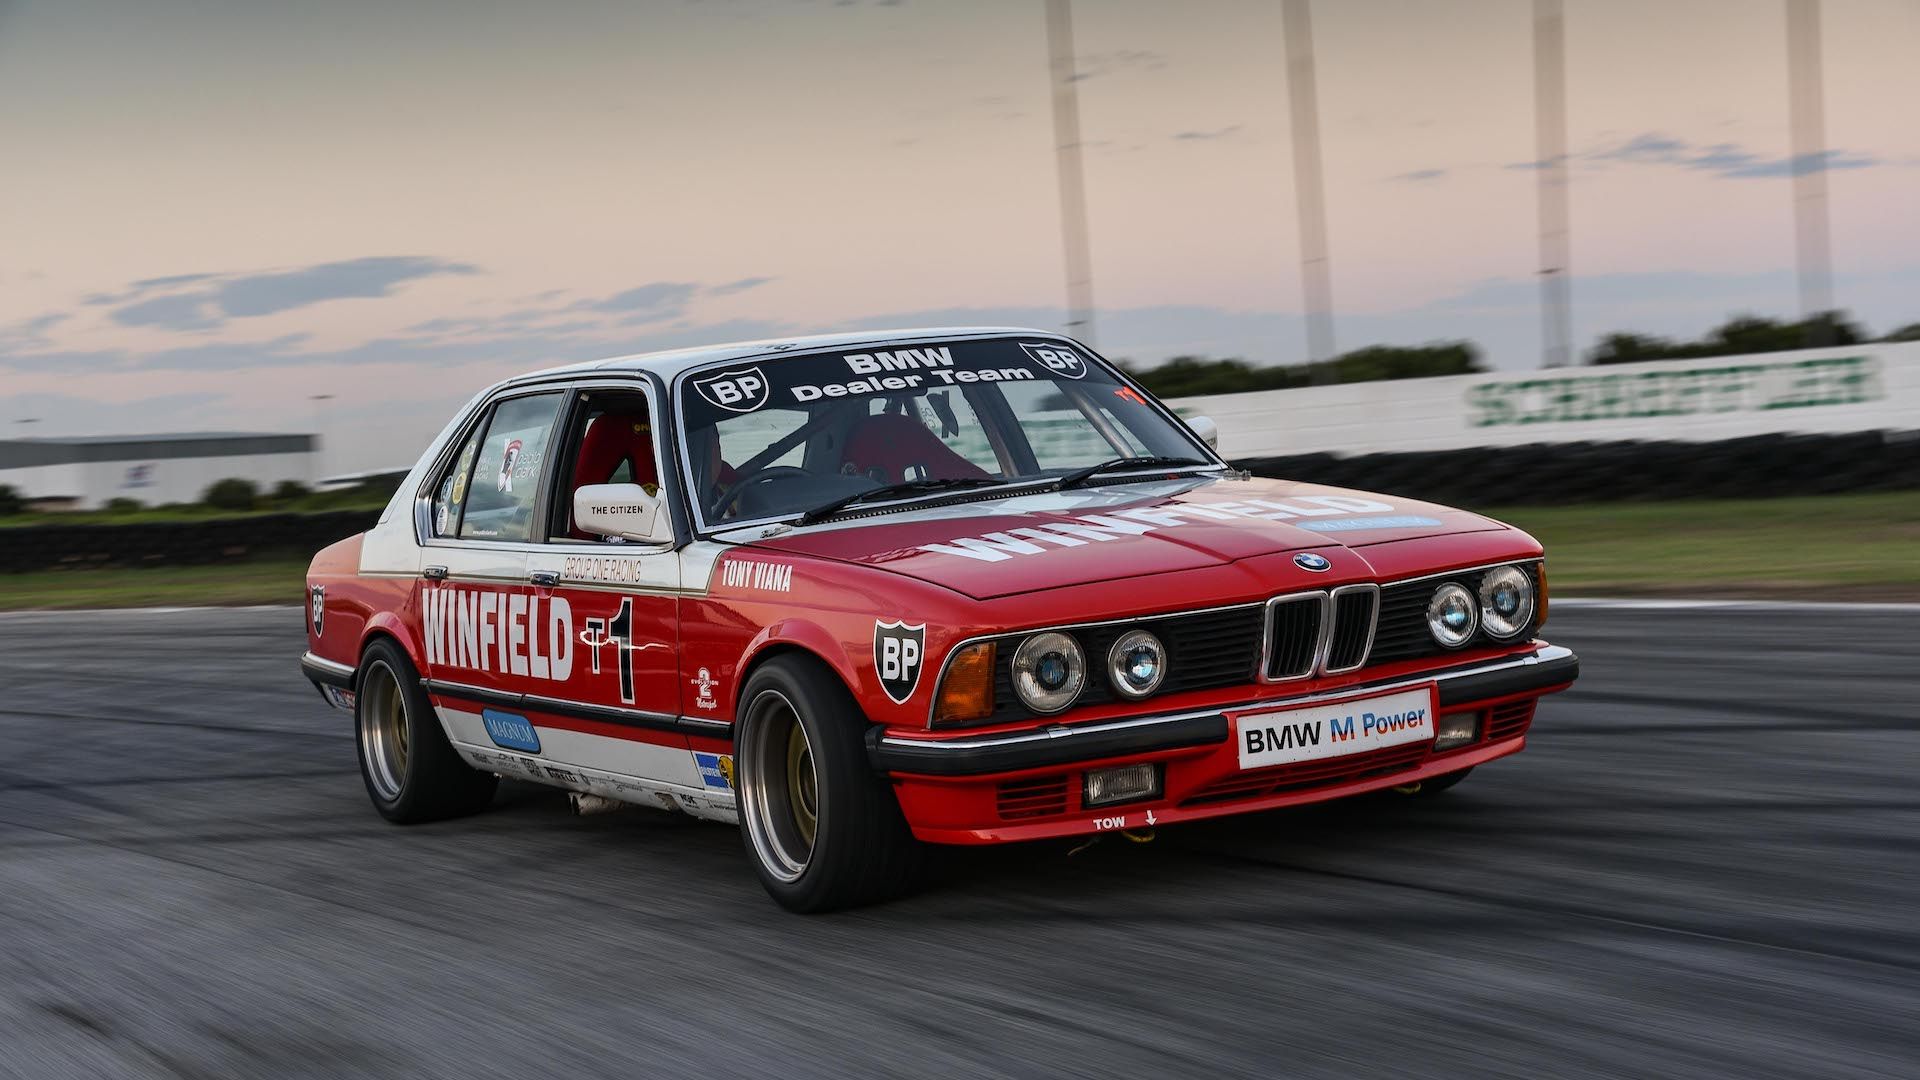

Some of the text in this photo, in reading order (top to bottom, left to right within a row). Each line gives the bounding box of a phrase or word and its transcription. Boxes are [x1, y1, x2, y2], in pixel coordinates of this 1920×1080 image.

[843, 347, 954, 375] BMW
[1035, 349, 1079, 370] BP
[709, 376, 762, 404] BP
[790, 364, 1035, 402] Dealer Team
[592, 505, 643, 515] THE CITIZEN
[915, 495, 1394, 562] WINFIELD
[565, 558, 641, 582] GROUP ONE RACING
[722, 560, 793, 592] TONY VIANA
[313, 594, 323, 622] BP
[422, 588, 573, 681] WINFIELD
[882, 637, 918, 681] BP
[698, 667, 712, 699] 2
[488, 718, 534, 743] MAGNUM
[1245, 707, 1426, 754] BMW M Power
[1093, 816, 1125, 830] TOW
